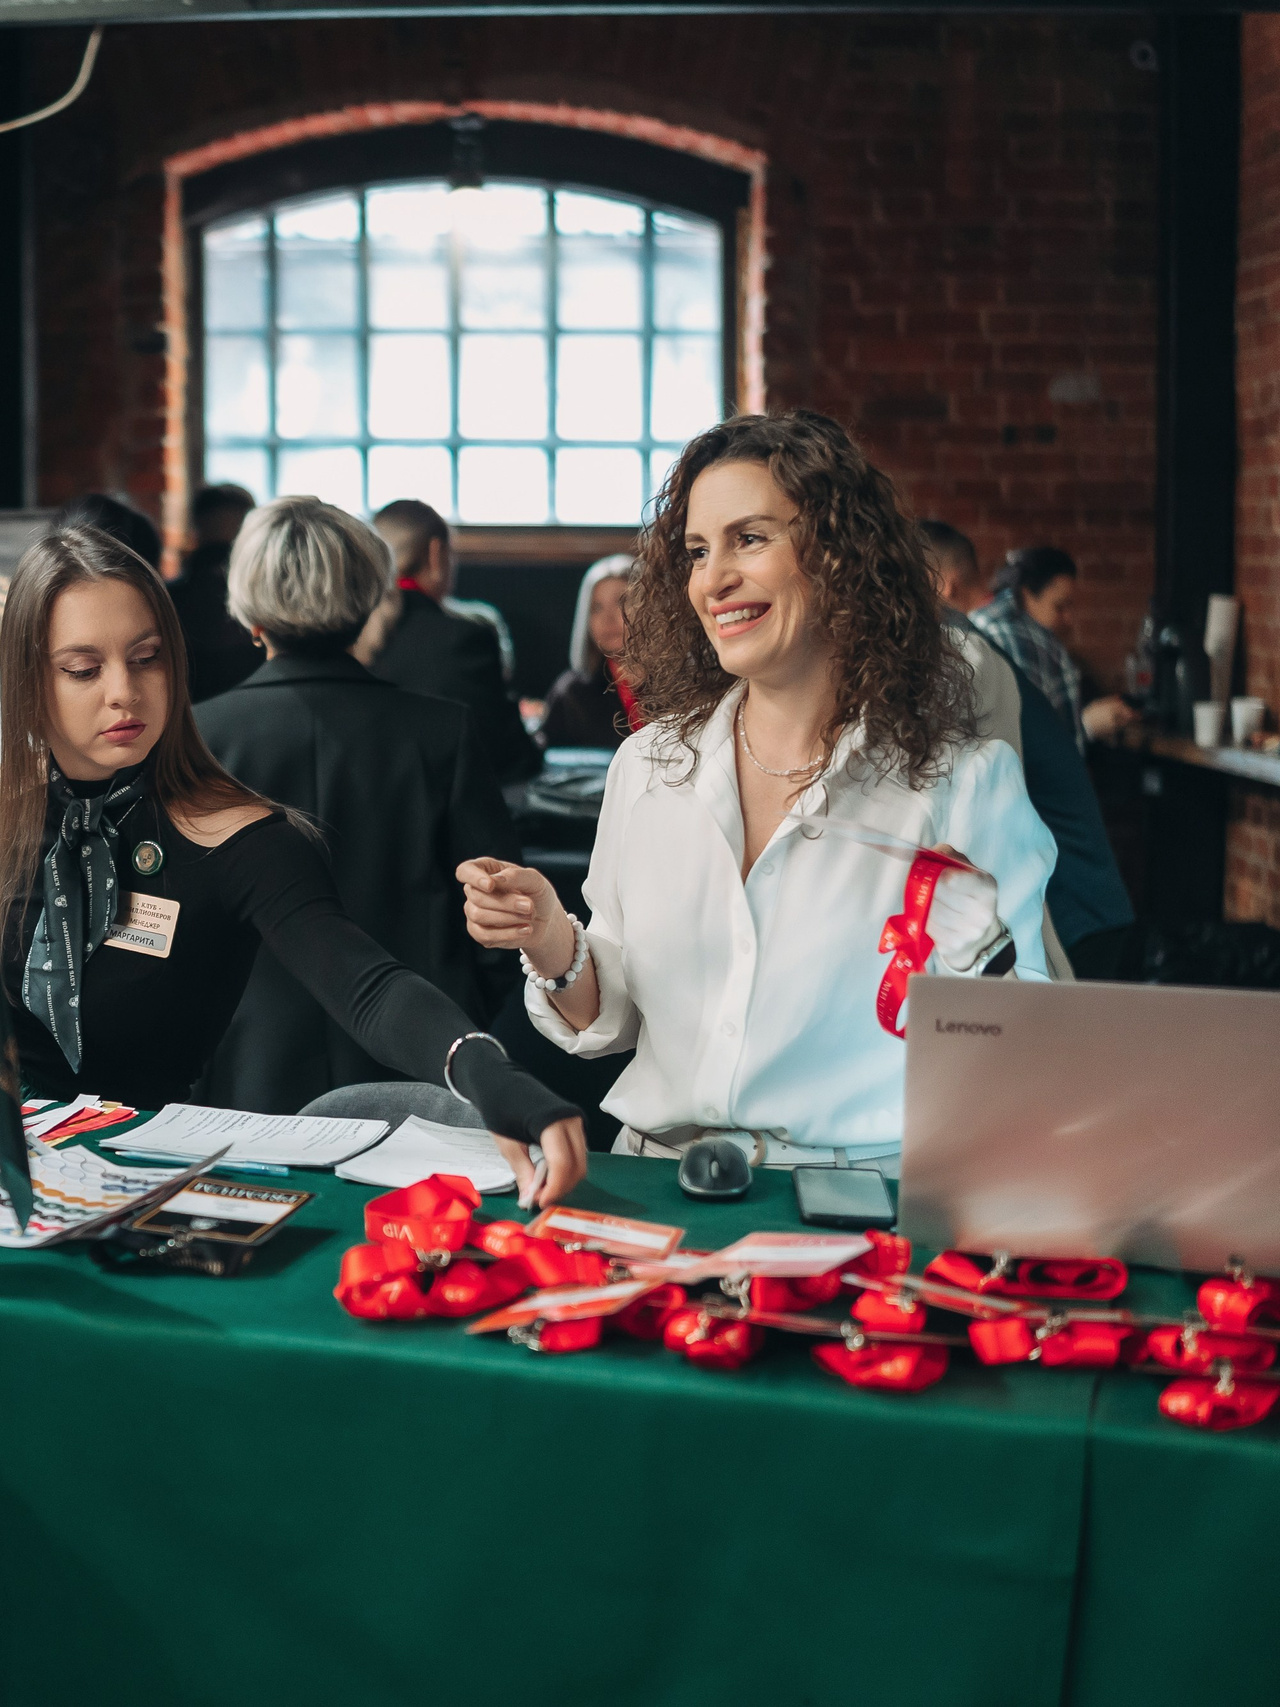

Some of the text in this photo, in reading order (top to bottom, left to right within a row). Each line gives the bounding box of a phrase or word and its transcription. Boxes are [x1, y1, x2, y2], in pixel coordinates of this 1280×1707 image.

[141, 902, 157, 911] КЛУБ
[130, 918, 161, 930] МЕНЕДЖЕР
[62, 921, 74, 969] МИЛЛИОНЕРОВ
[109, 929, 155, 947] МАРГАРИТА
[934, 1018, 1003, 1037] Lenovo
